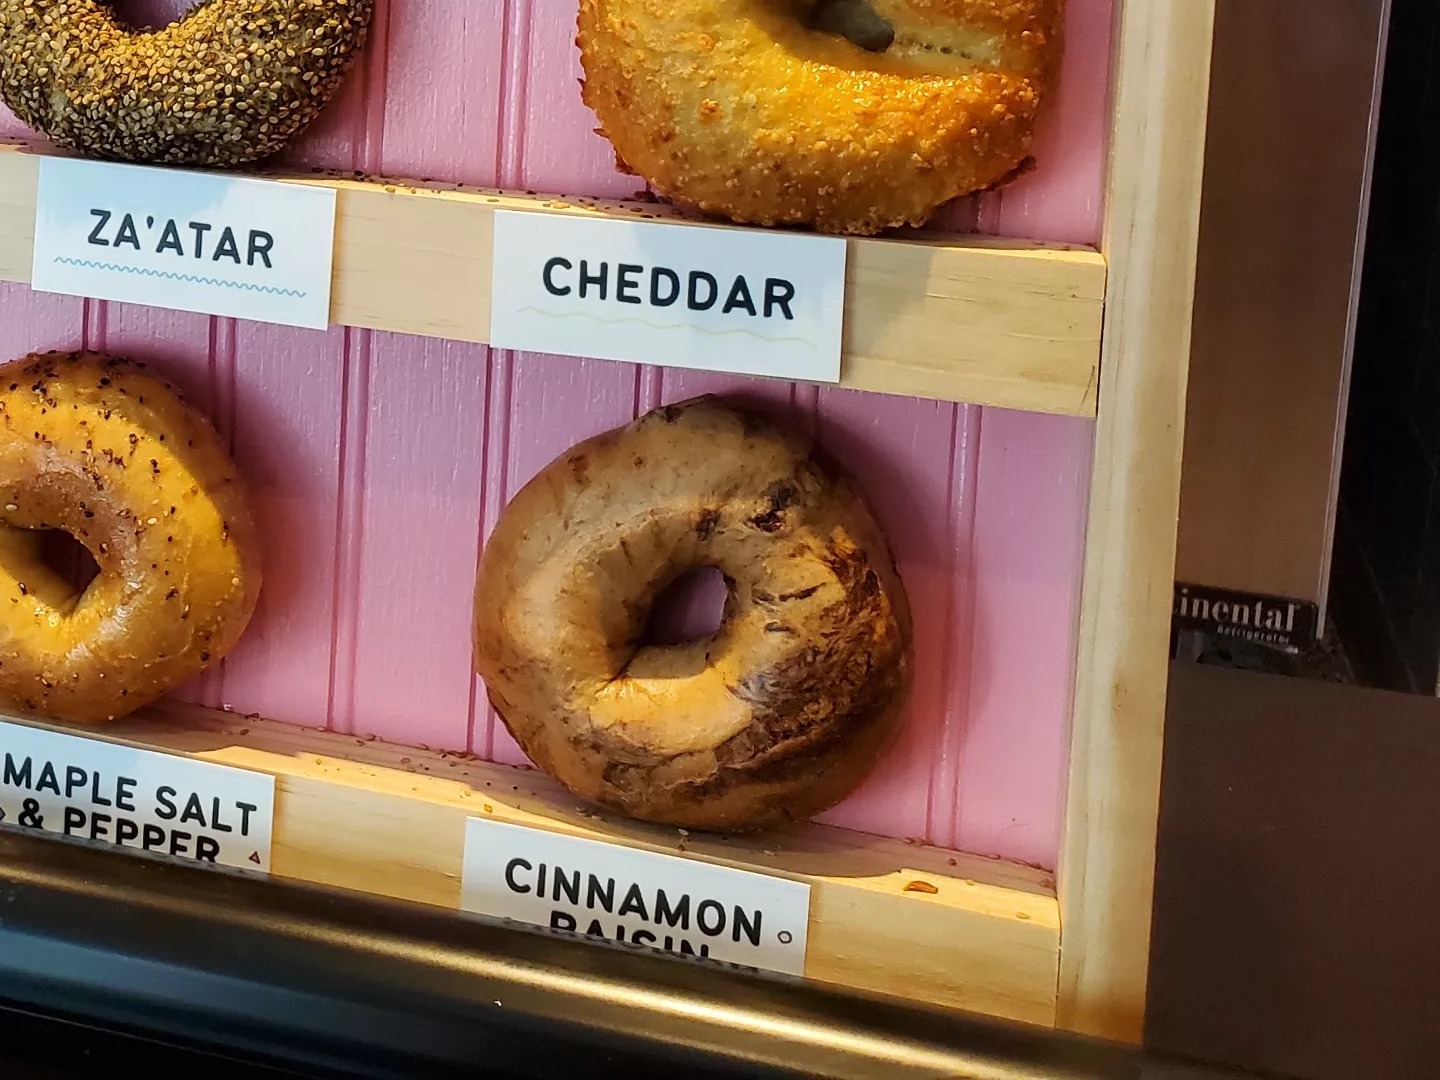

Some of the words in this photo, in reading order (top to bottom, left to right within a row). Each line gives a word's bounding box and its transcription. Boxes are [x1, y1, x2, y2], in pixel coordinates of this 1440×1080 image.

[88, 208, 274, 270] ZA'ATAR
[542, 257, 795, 321] CHEDDAR
[1175, 587, 1295, 632] inental
[3, 752, 138, 812] MAPLE
[154, 785, 257, 836] SALT
[18, 797, 44, 829] &
[63, 806, 220, 863] PEPPER
[505, 858, 762, 947] CINNAMON
